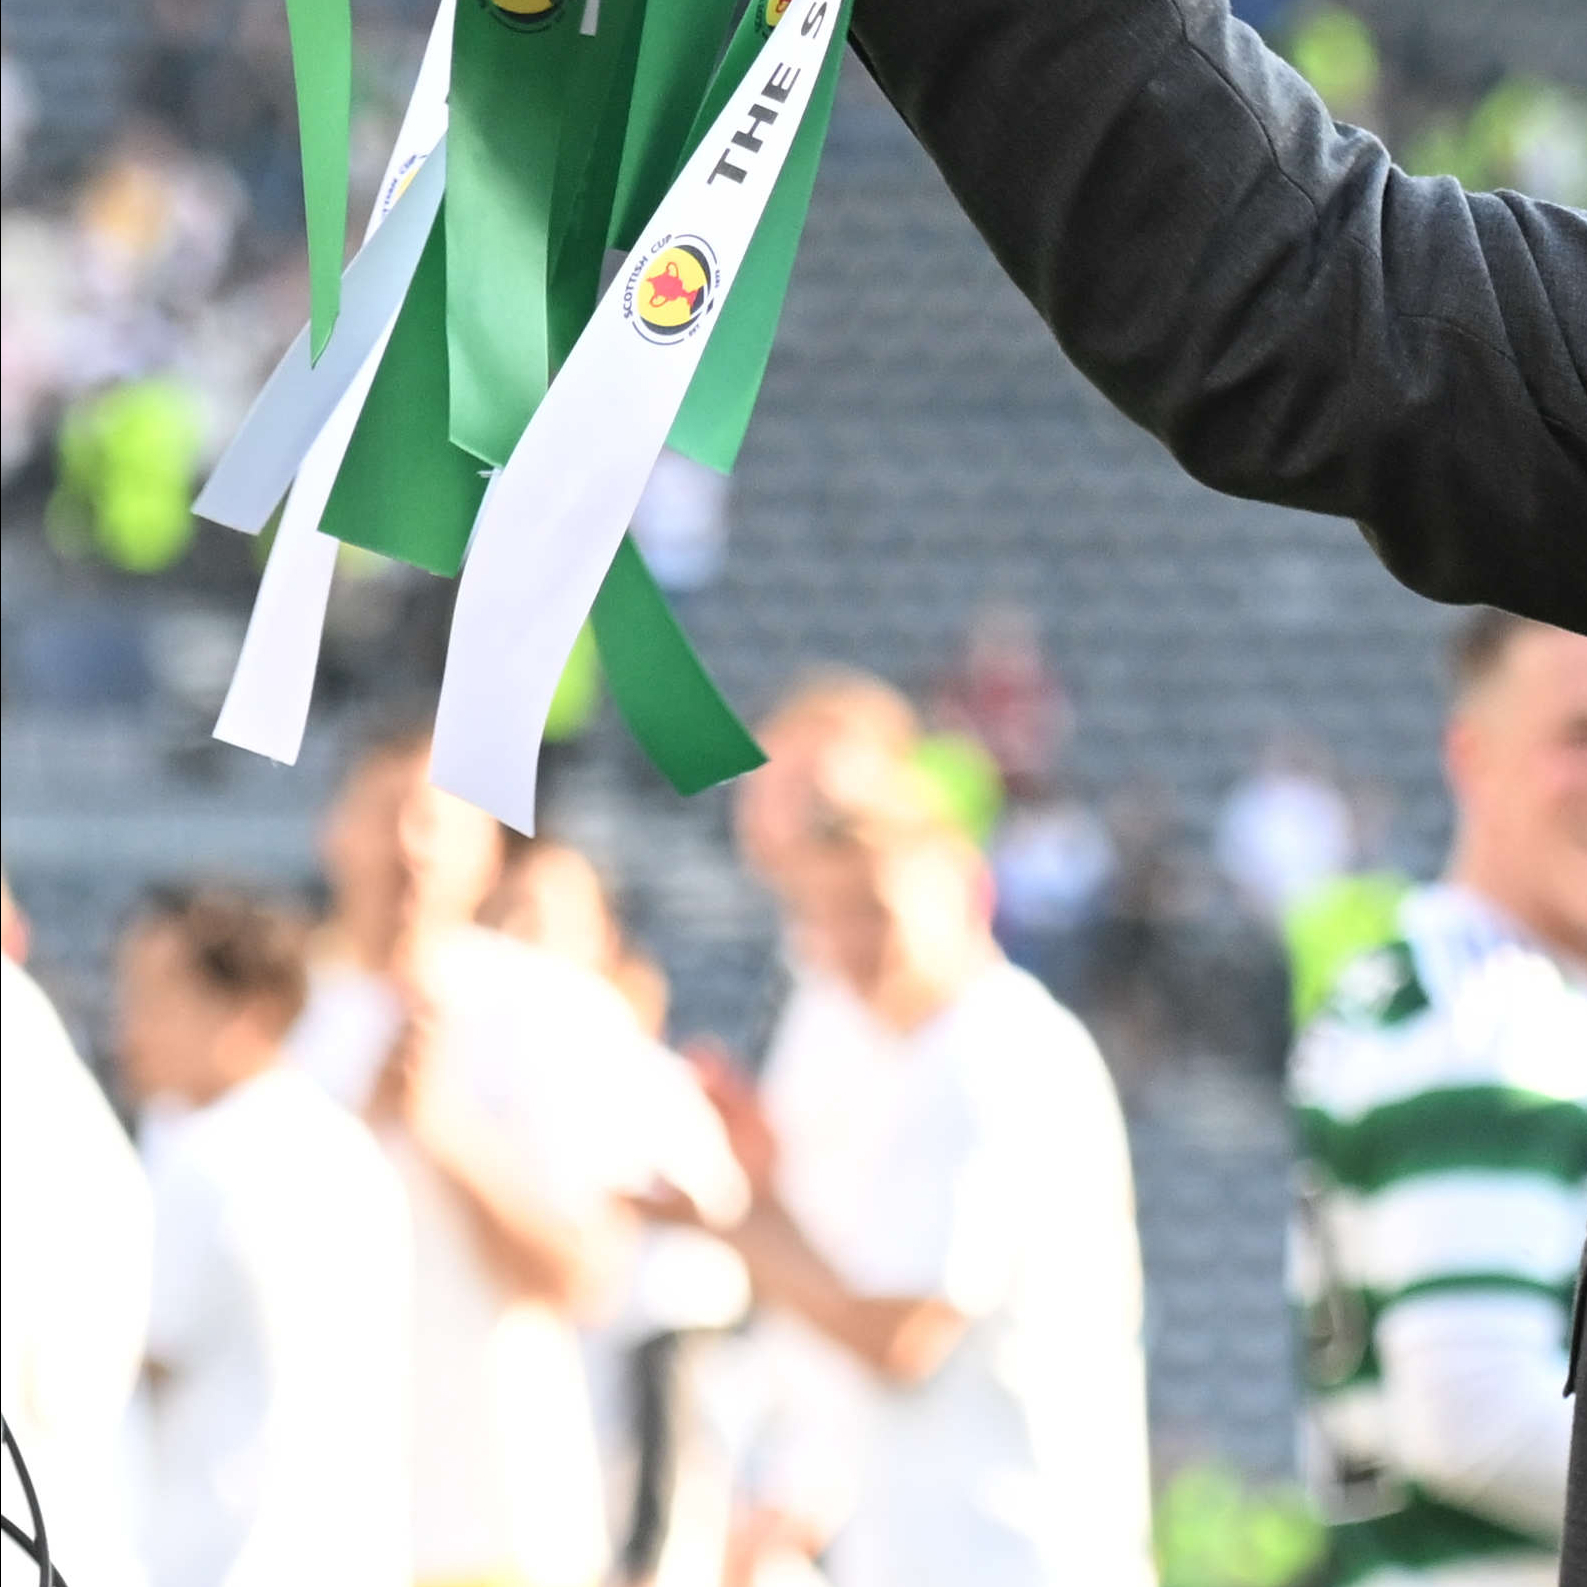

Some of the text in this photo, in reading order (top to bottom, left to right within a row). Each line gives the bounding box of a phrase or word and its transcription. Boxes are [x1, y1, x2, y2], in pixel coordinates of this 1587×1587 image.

[706, 62, 802, 185] THE
[623, 233, 672, 319] SCOTTISH CUP
